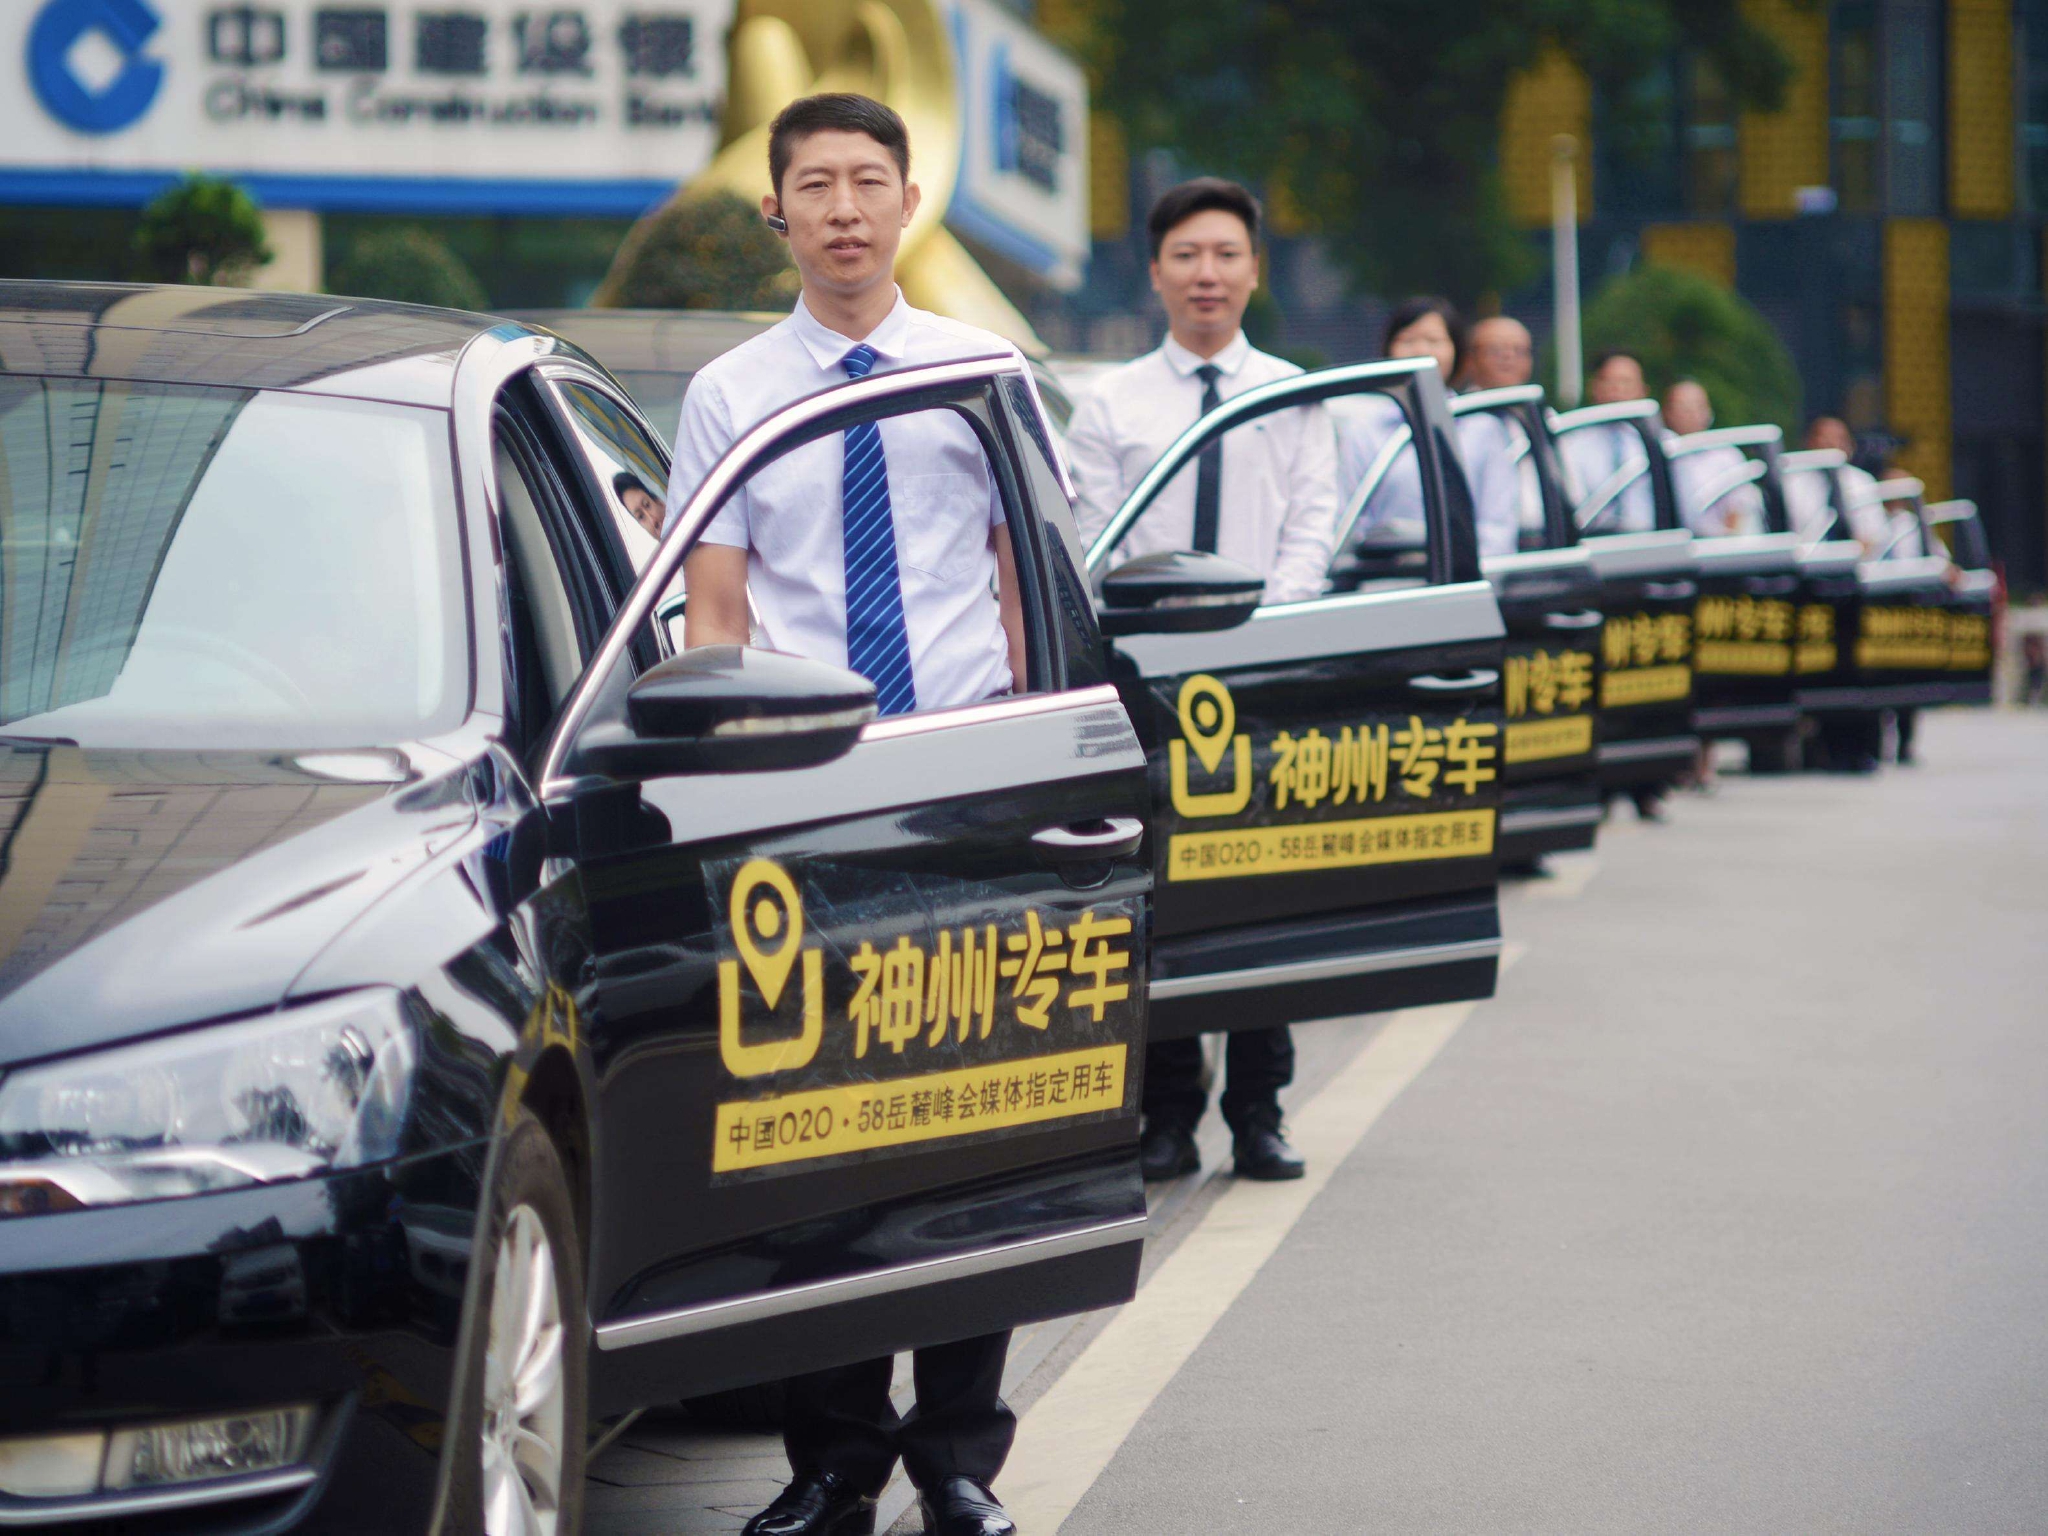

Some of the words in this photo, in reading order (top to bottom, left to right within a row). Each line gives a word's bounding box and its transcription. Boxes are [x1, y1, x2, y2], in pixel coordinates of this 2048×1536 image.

[1269, 716, 1497, 810] 神州专车
[848, 909, 1133, 1060] 神州专车
